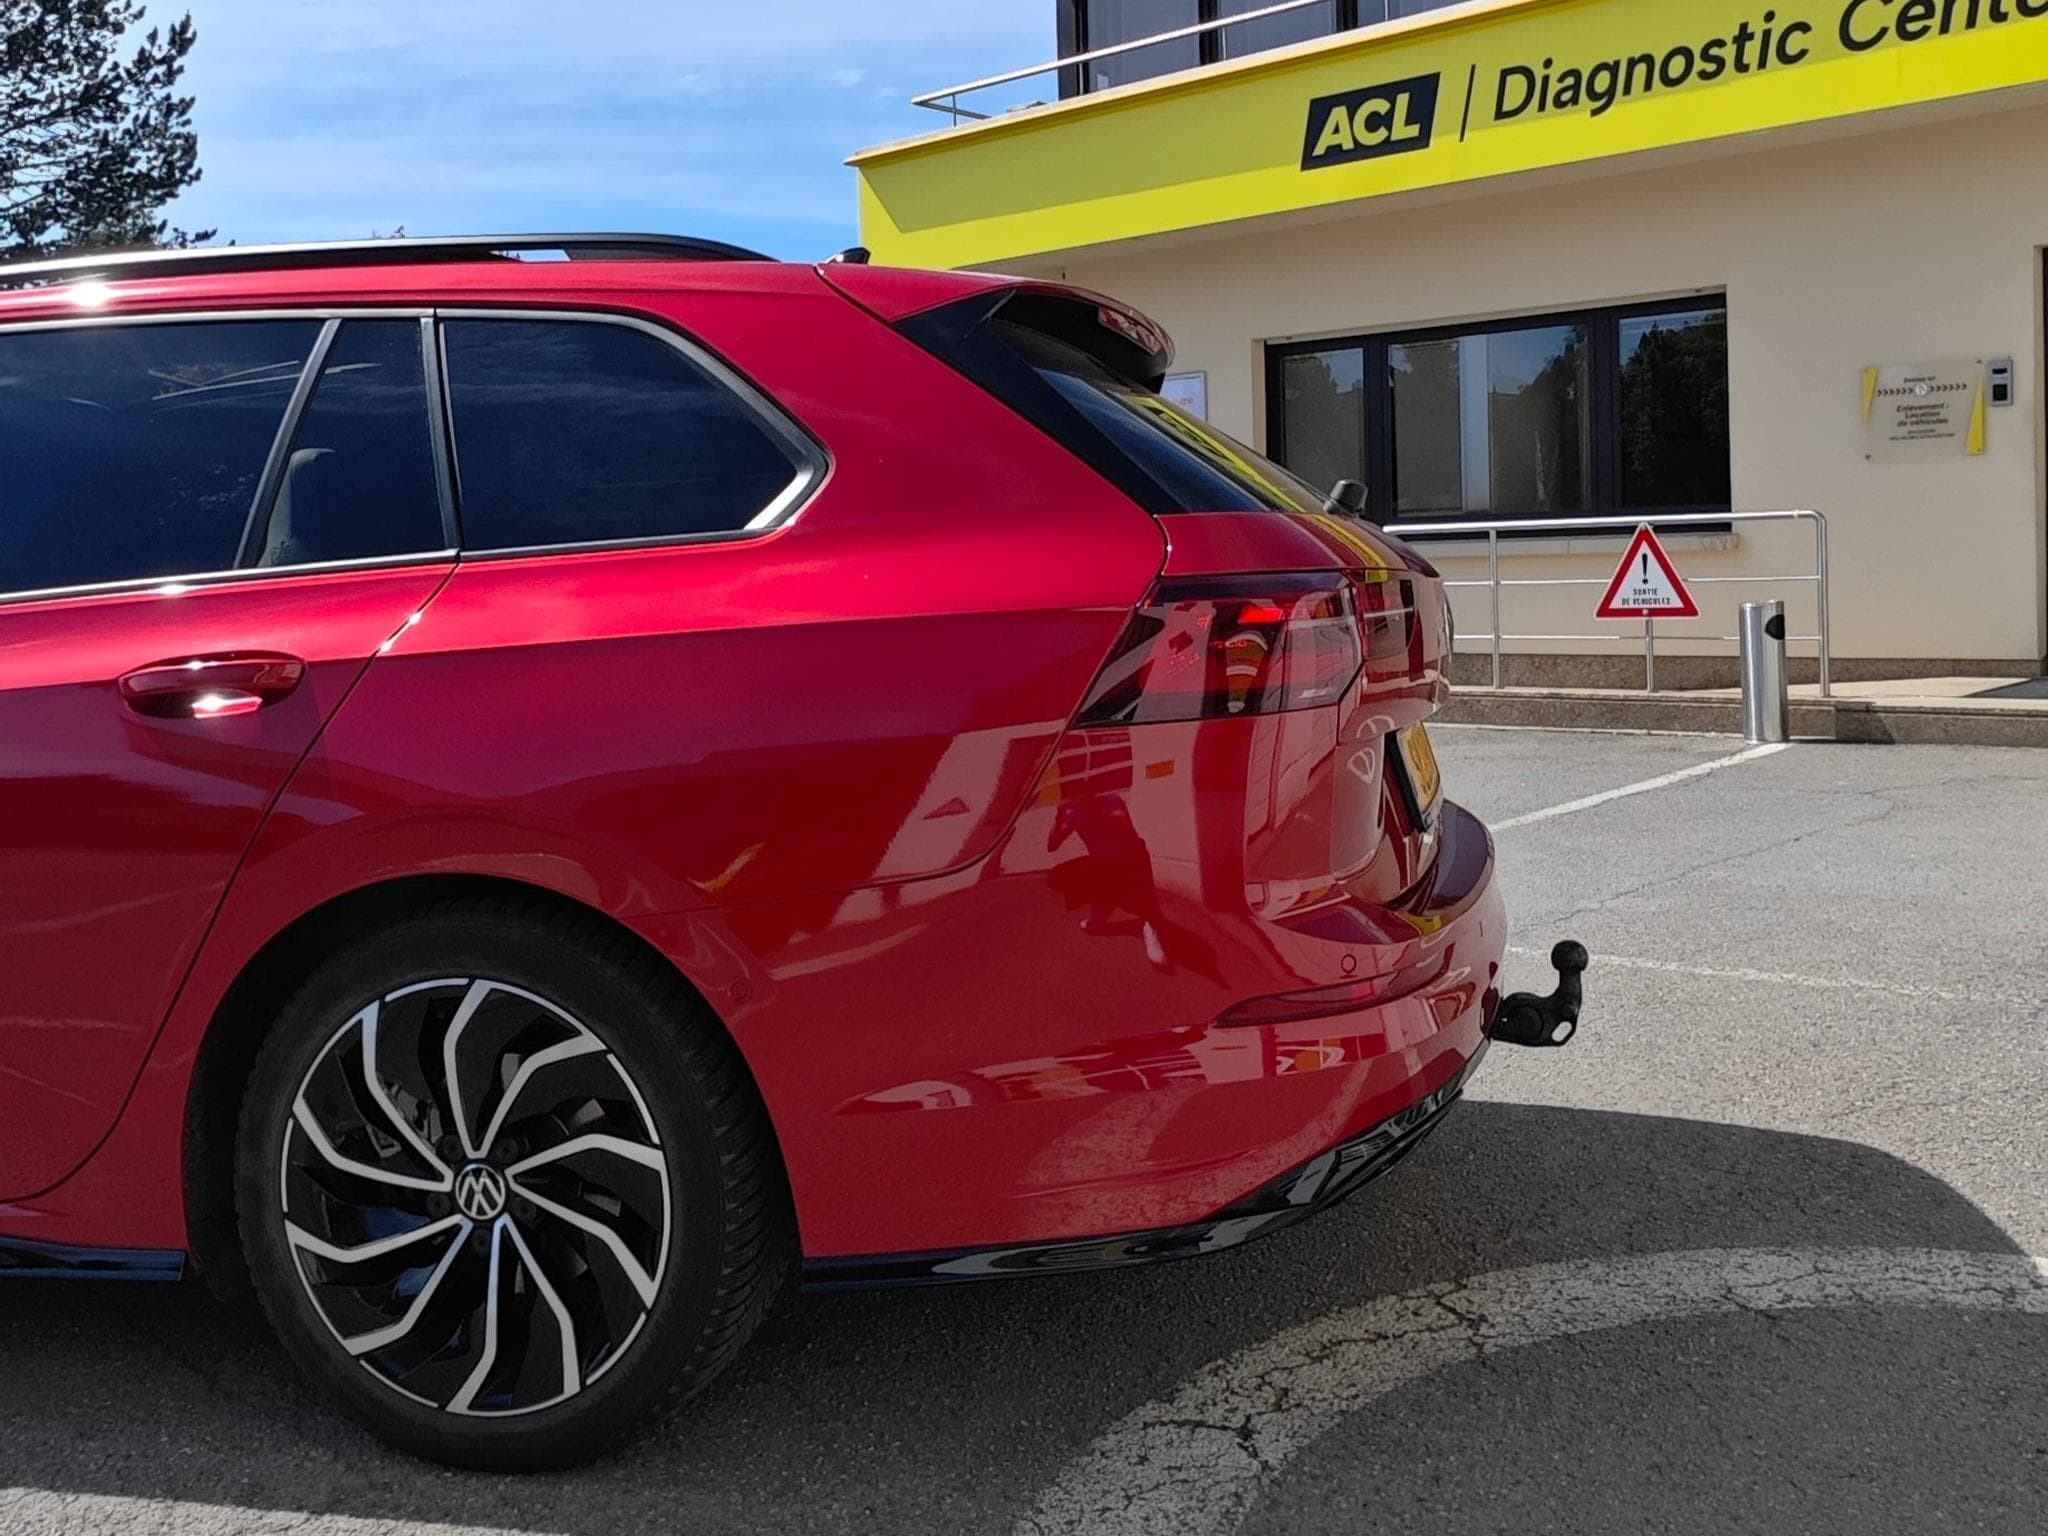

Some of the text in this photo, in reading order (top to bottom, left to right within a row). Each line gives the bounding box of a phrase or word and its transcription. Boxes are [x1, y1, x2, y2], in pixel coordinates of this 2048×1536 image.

[1312, 91, 1422, 157] ACL
[1493, 9, 1813, 122] Diagnostic
[1633, 588, 1658, 596] SORTIE
[1621, 598, 1630, 606] DE
